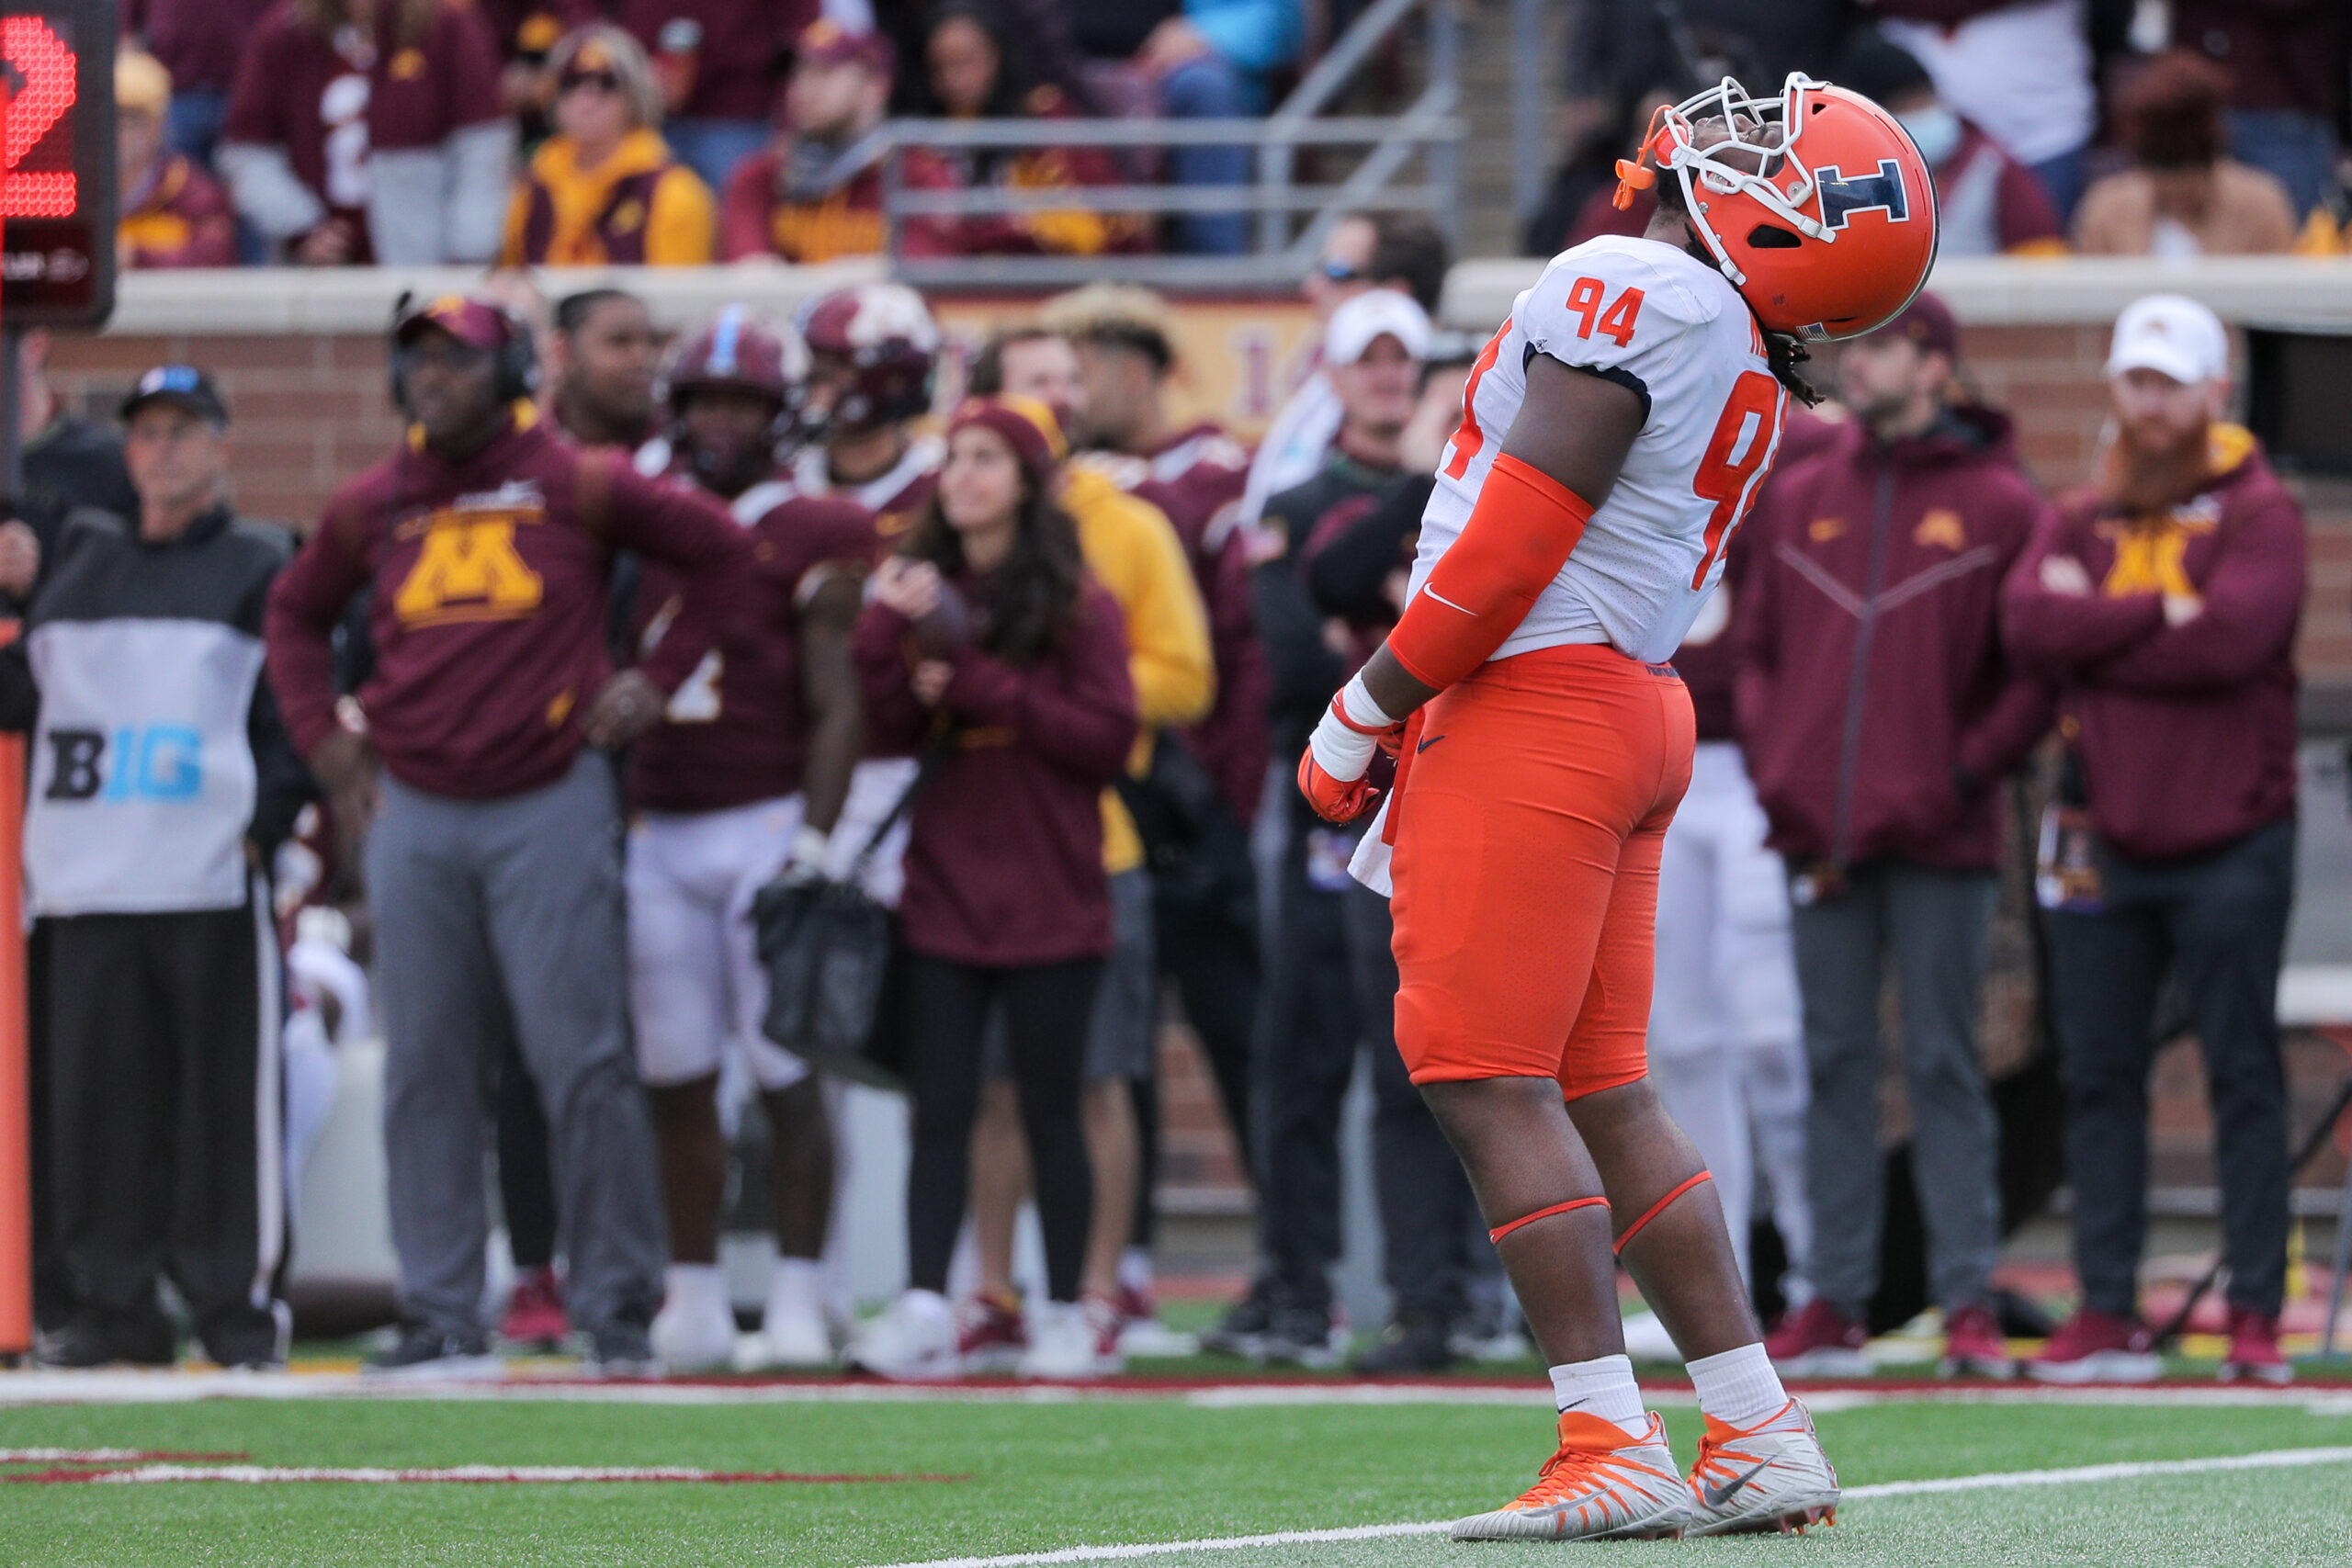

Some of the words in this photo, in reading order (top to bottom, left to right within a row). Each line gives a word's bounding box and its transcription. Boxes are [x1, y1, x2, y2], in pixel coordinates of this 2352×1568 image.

[0, 17, 78, 218] 2
[1814, 159, 1909, 231] I
[1565, 276, 1645, 348] 94
[393, 508, 548, 632] M
